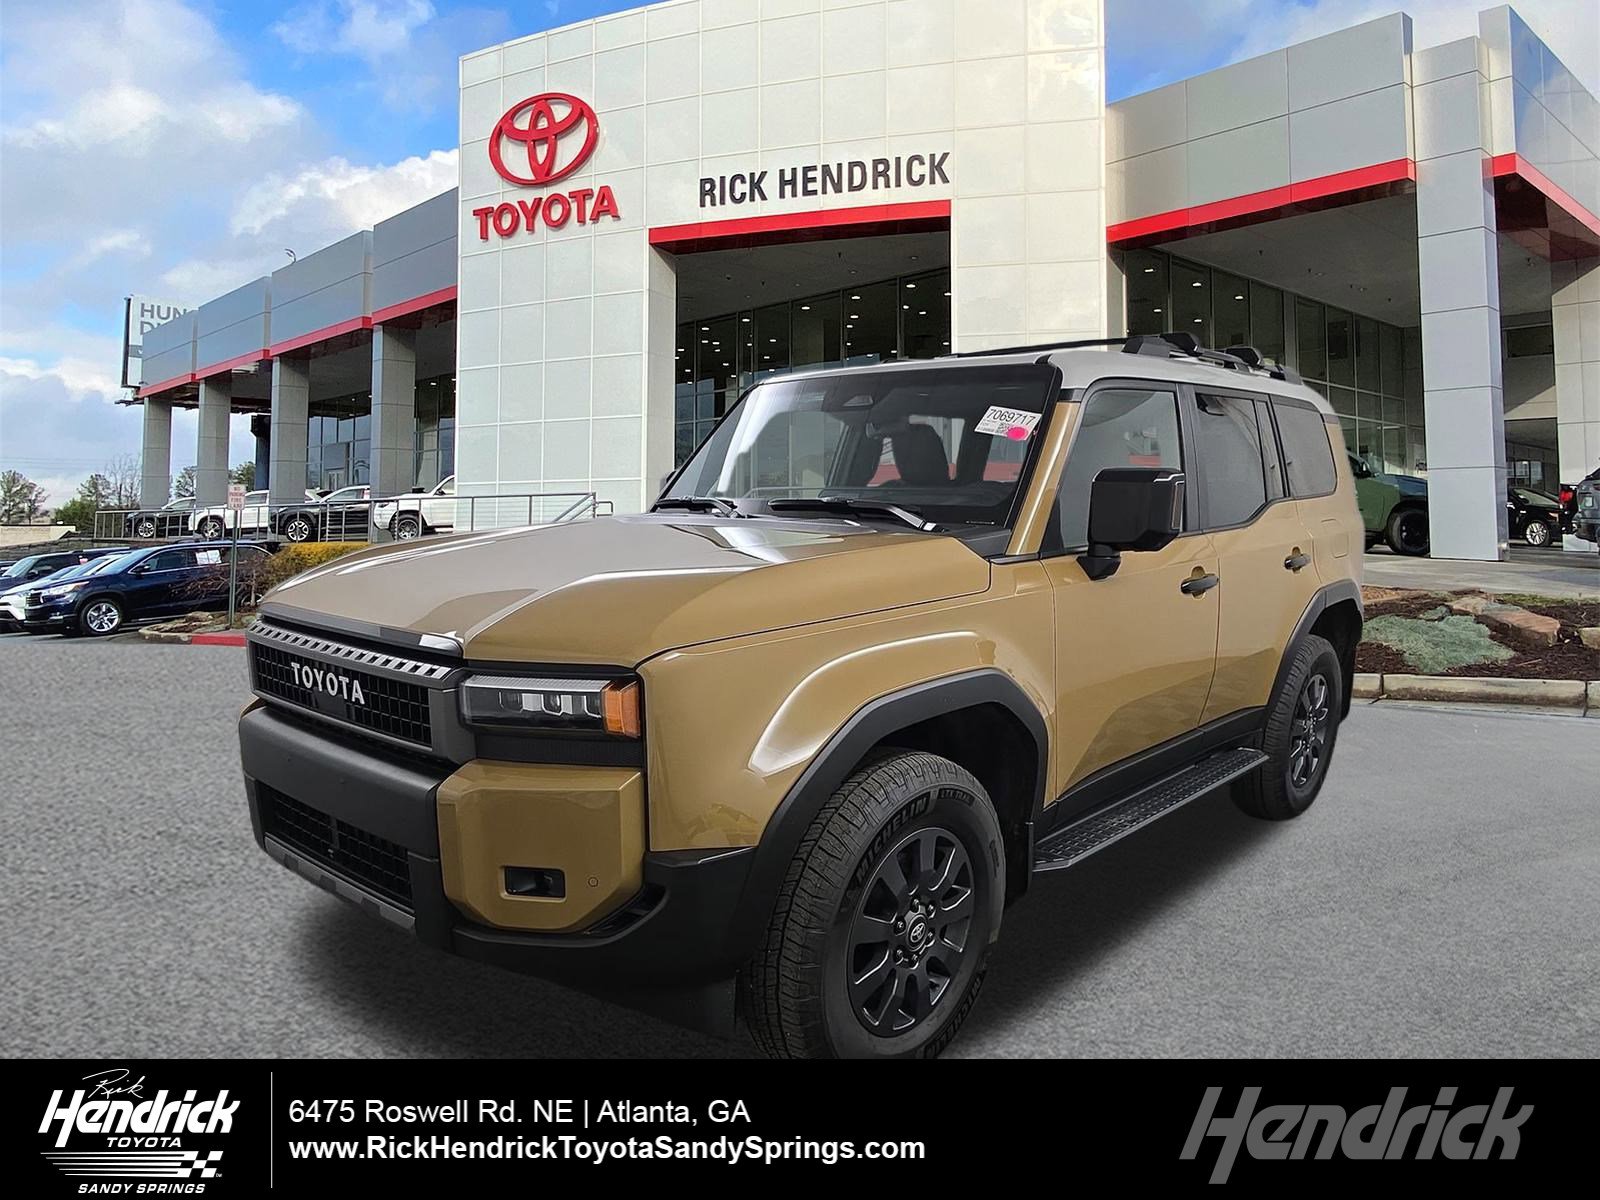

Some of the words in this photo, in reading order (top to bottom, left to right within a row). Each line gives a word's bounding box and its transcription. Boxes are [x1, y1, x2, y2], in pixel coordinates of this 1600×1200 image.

[700, 170, 768, 207] RICK
[779, 152, 951, 200] HENDRICK
[473, 185, 620, 240] TOYOTA
[986, 408, 1036, 425] 7069717
[291, 662, 365, 705] TOYOTA
[854, 796, 928, 884] MICHELIN
